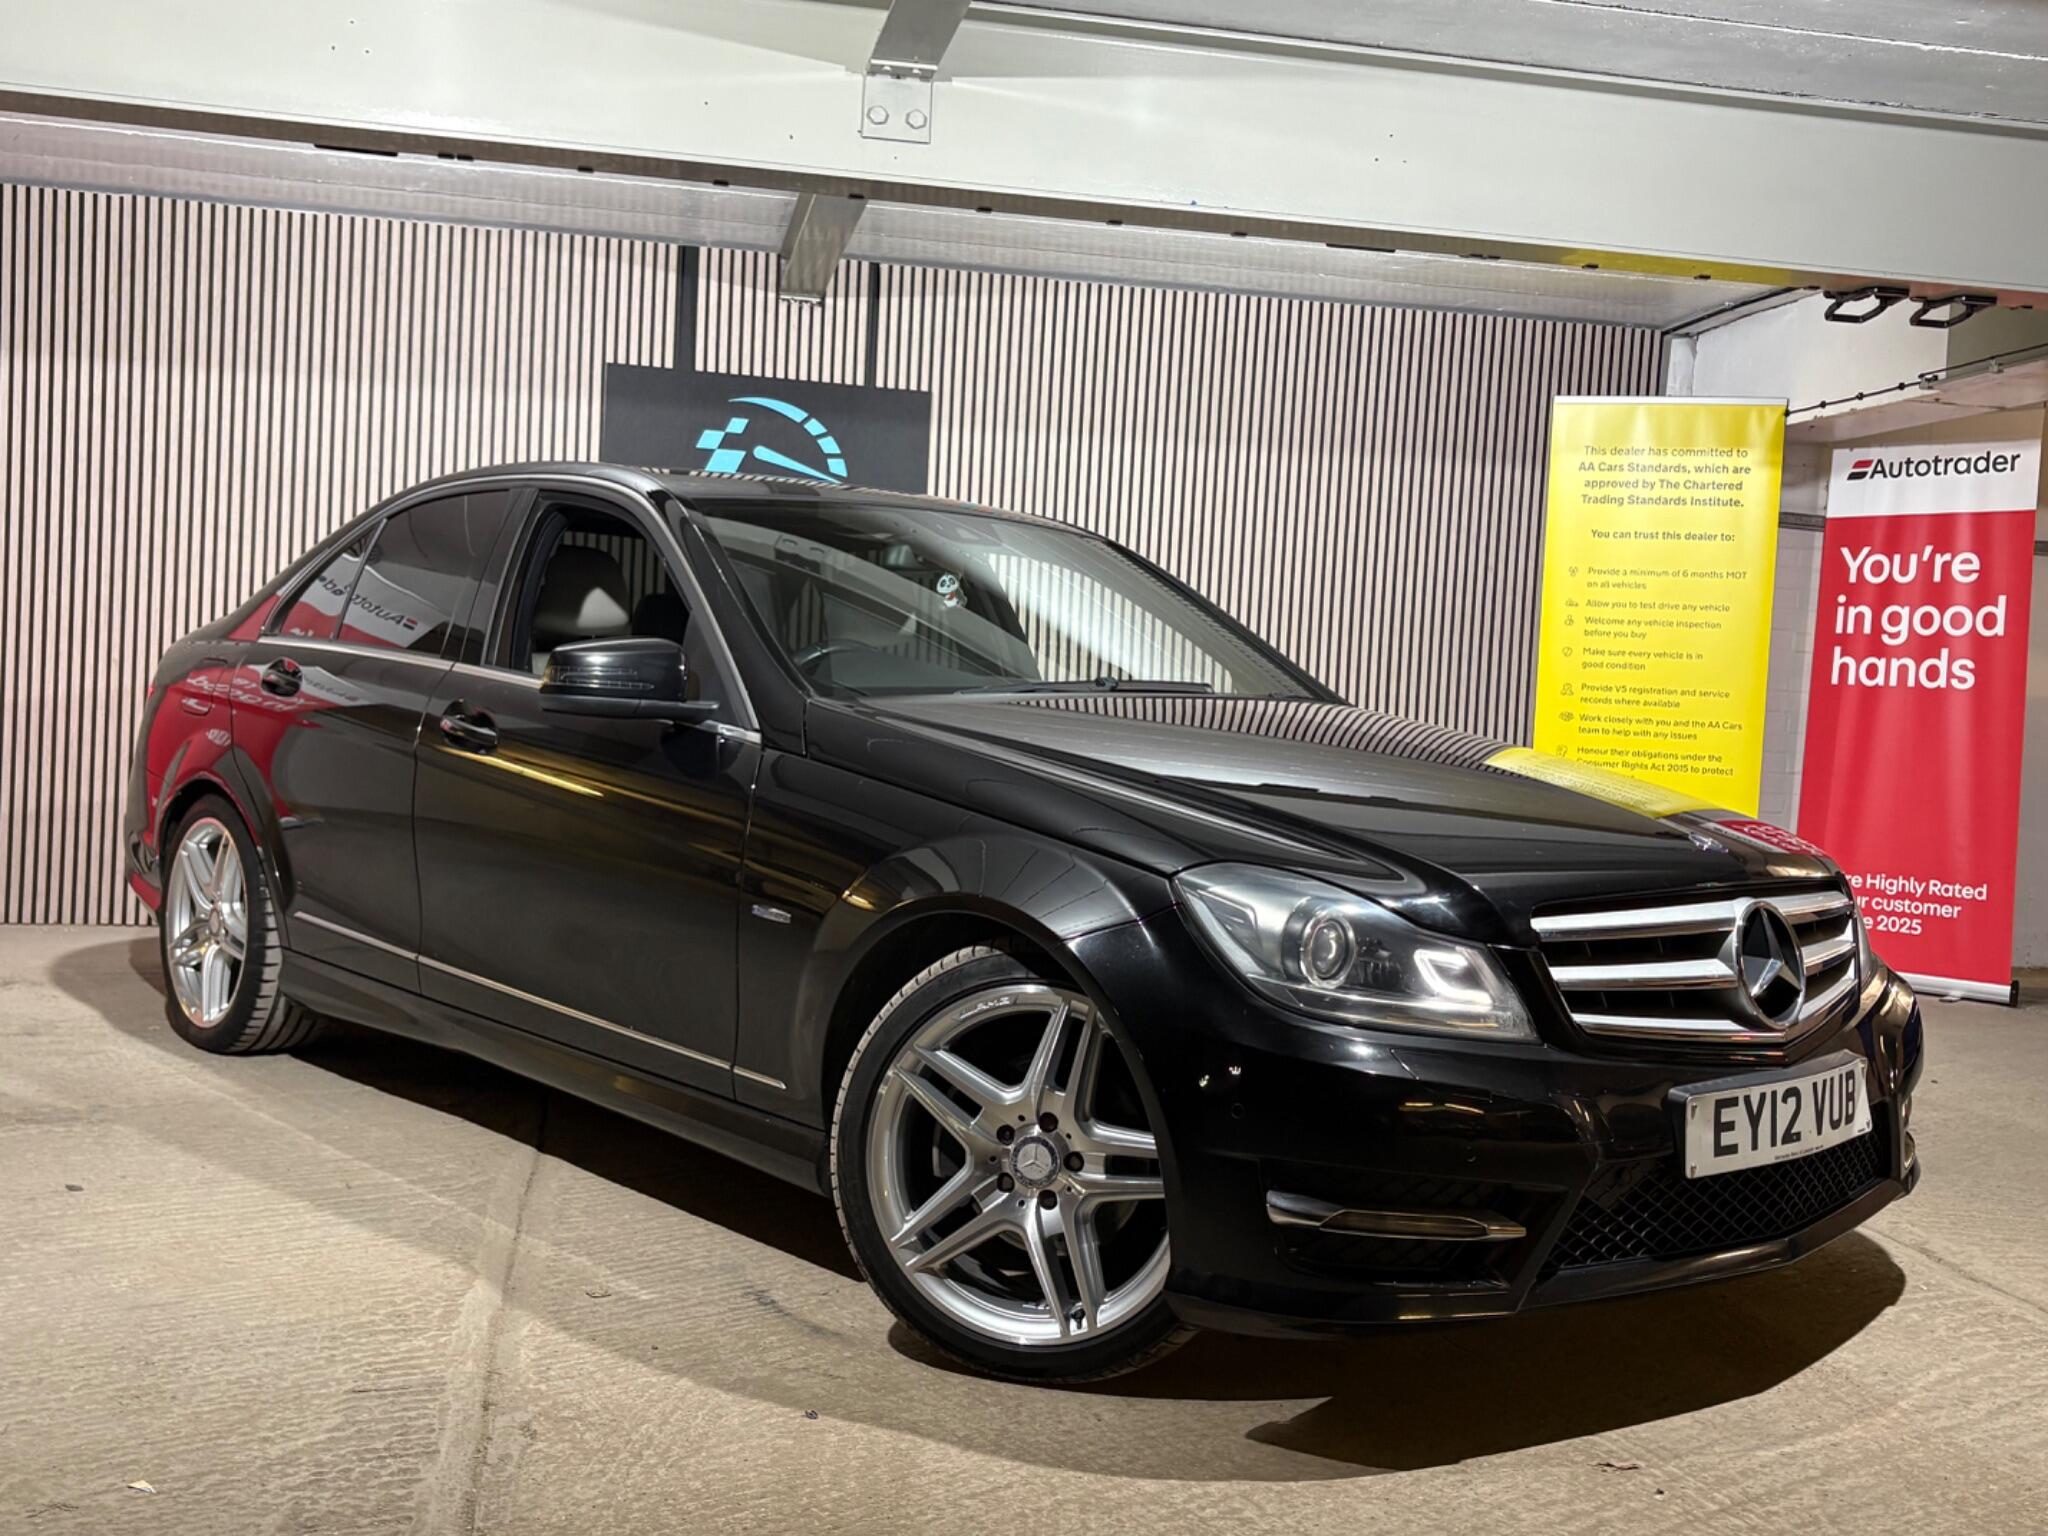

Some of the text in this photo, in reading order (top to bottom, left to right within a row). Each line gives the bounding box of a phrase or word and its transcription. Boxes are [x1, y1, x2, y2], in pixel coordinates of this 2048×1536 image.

[1584, 445, 1749, 458] This dealer has committed to
[1578, 461, 1752, 475] AA Cars Standards, which are
[1869, 450, 2021, 480] Autotrader
[1584, 478, 1744, 491] approved by The Chartered
[1581, 494, 1745, 507] Trading Standards Institute.
[1591, 528, 1736, 542] You can trust this dealer to:
[1840, 545, 1981, 585] You're
[1587, 566, 1621, 576] Provide
[1629, 567, 1670, 578] minimum
[1671, 569, 1680, 578] of
[1682, 569, 1689, 578] 6
[1690, 570, 1725, 580] months
[1726, 571, 1748, 580] MOT
[1586, 580, 1648, 590] on all vehicles
[1585, 599, 1731, 613] Allow you to test drive any vehicle
[1584, 616, 1722, 630] Welcome any vehicle inspection
[1834, 594, 2008, 646] in good
[1584, 628, 1648, 641] before you buy
[1583, 647, 1704, 661] Make sure every vehicle is in
[1581, 661, 1646, 672] good condition
[1831, 646, 1976, 690] hands
[1581, 682, 1731, 699] Provide V5 registration and service
[1580, 696, 1681, 709] records where available
[1579, 713, 1744, 731] Work closely with you and the AA Cars
[1578, 726, 1698, 741] team to help with any issues
[1577, 746, 1723, 763] Honour their obligations under the
[1622, 760, 1649, 772] Rights
[1650, 763, 1665, 772] Act
[1668, 764, 1689, 774] 2015
[1691, 765, 1701, 774] to
[1702, 767, 1735, 777] protect
[1866, 873, 1927, 898] Highly
[1928, 879, 1988, 901] Rated
[1871, 896, 1962, 919] customer
[1876, 914, 1923, 936] 2025
[1713, 1069, 1857, 1158] EY12 VUB
